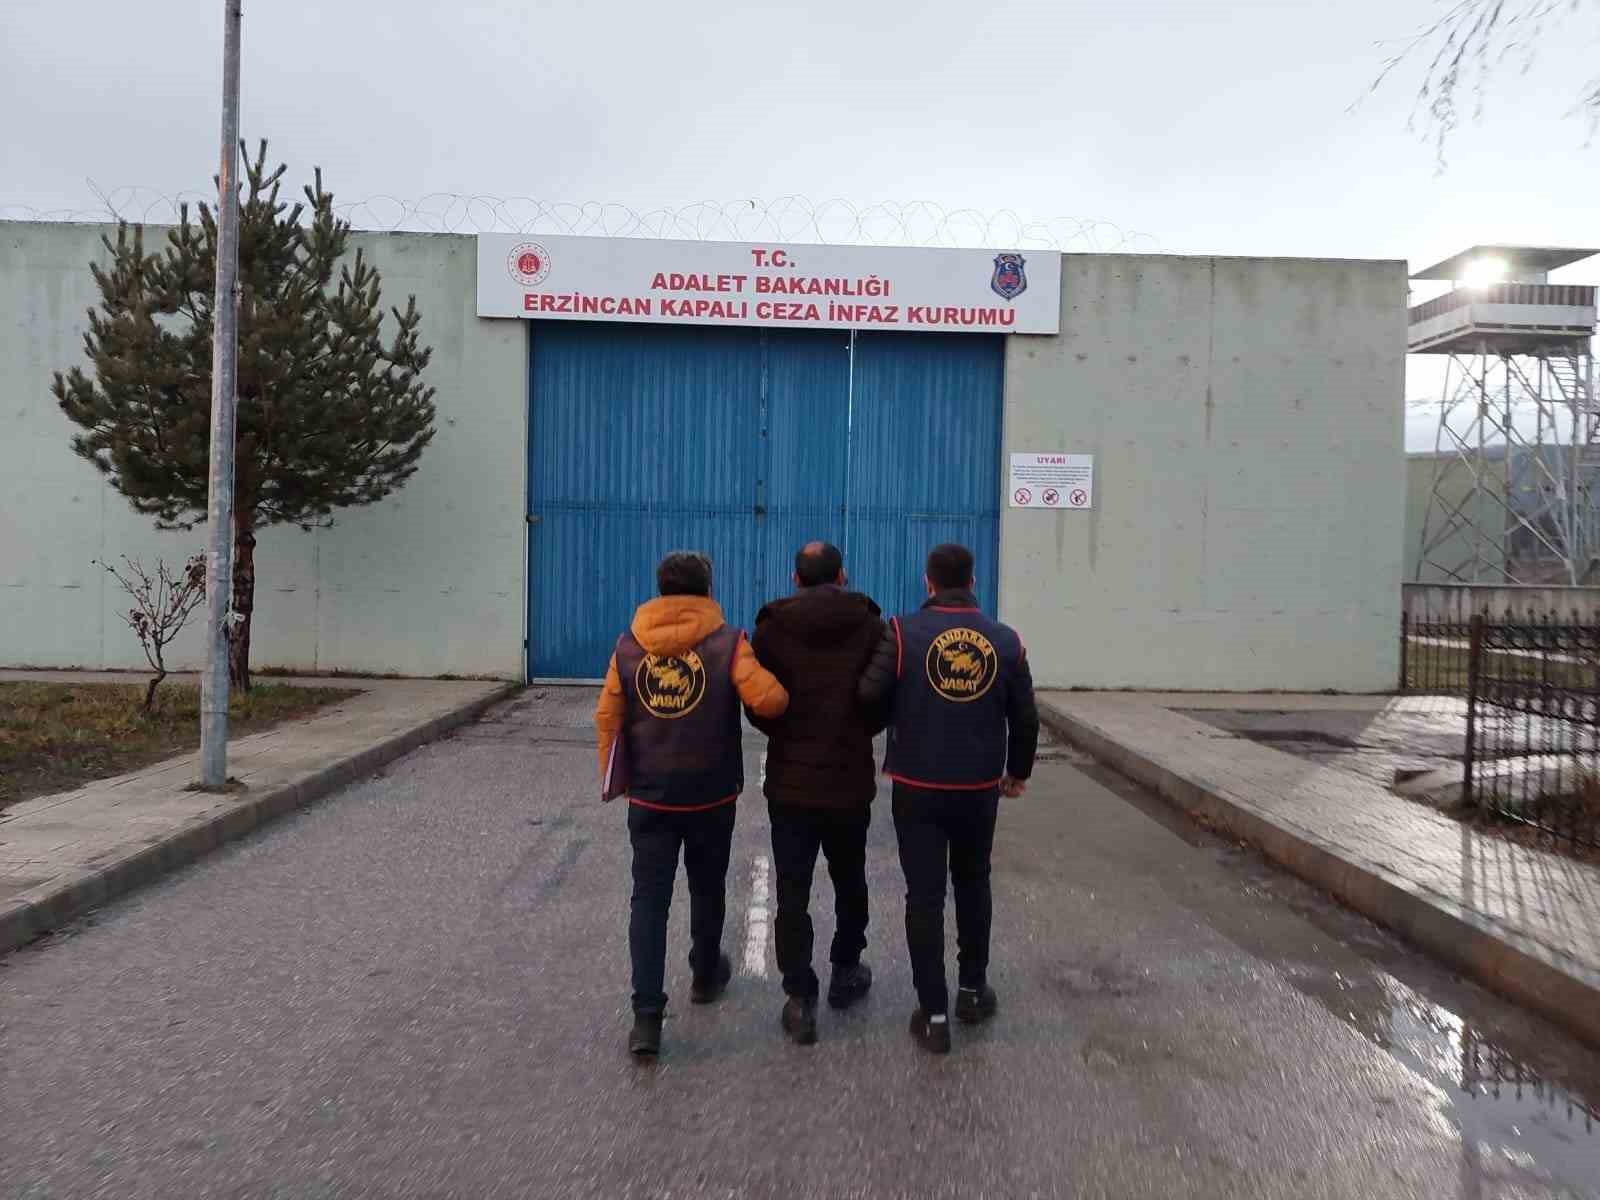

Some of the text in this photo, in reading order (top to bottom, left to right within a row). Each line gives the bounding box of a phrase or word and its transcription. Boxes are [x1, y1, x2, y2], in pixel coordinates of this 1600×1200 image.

[752, 249, 796, 268] T.C.
[651, 273, 891, 297] ADALET BAKANLIĞI
[523, 292, 1015, 325] ERZİNCAN KAPALI CEZA İNFAZ KURUMU
[1037, 456, 1066, 465] UYARI
